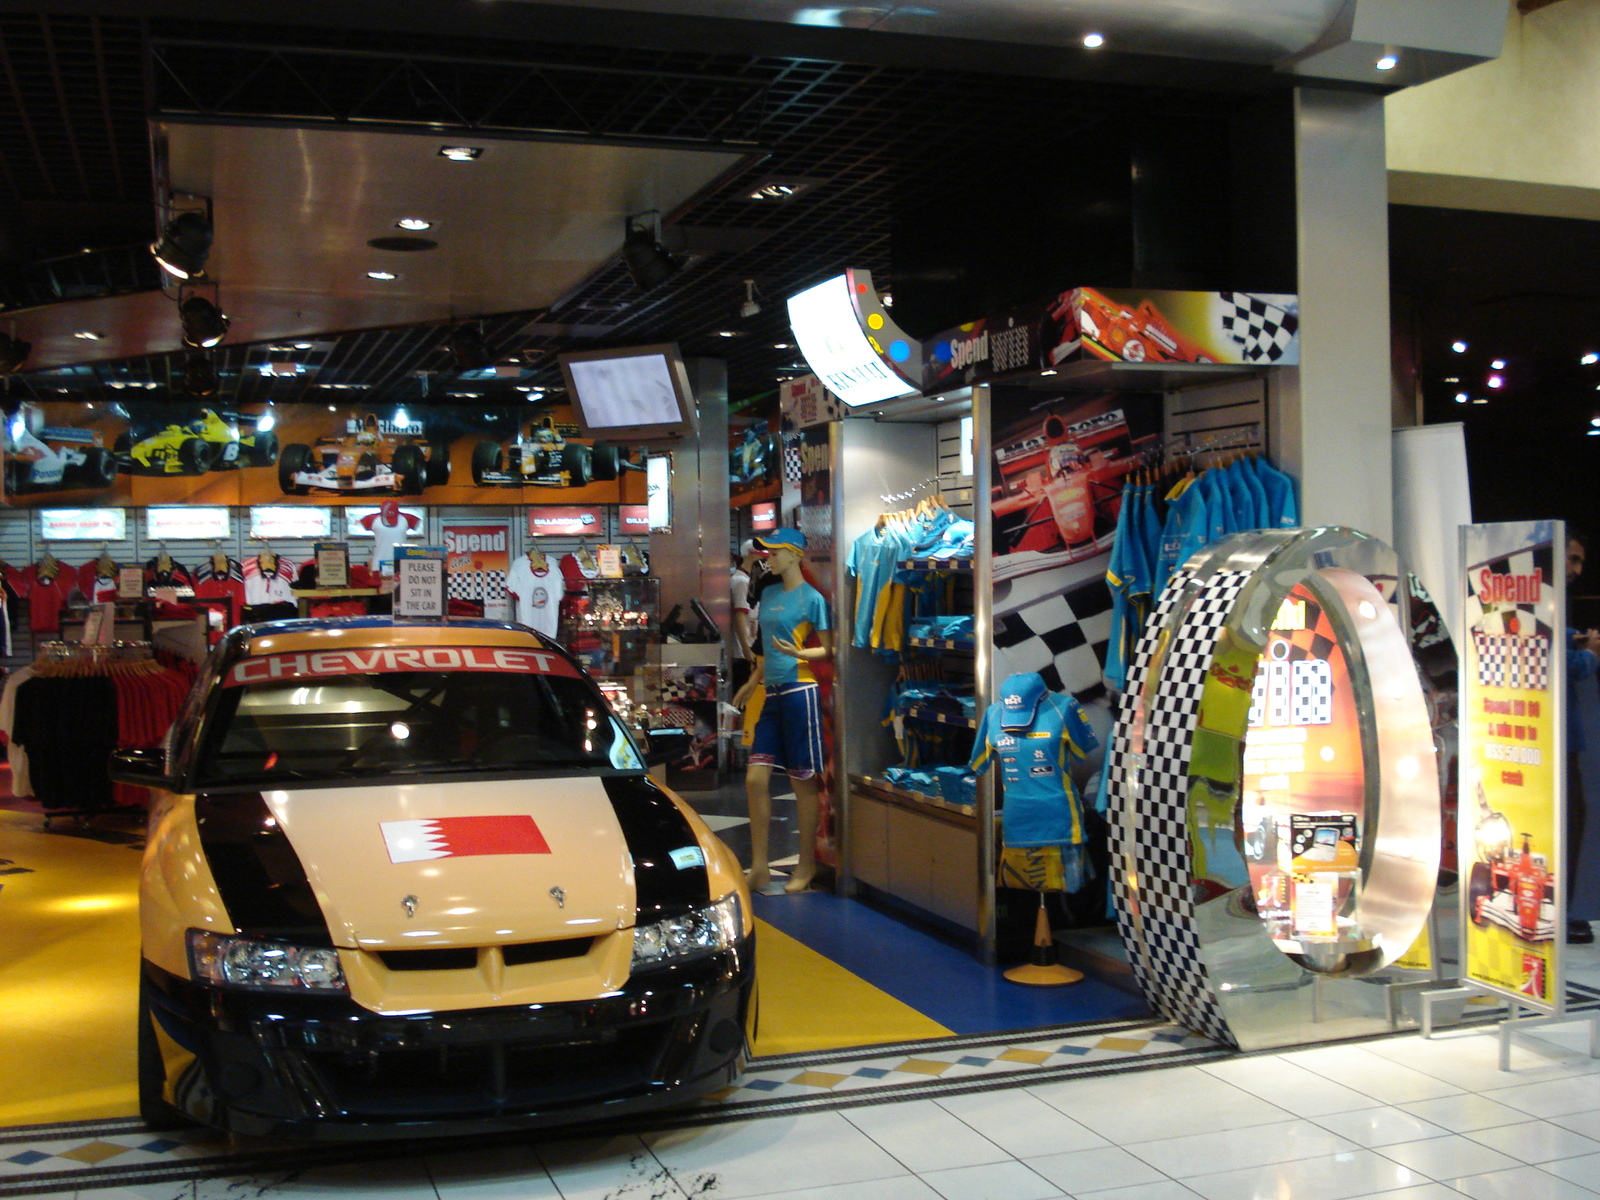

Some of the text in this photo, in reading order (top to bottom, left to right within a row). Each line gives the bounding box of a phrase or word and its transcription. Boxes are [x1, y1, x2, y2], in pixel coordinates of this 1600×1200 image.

[950, 329, 988, 370] Spend
[354, 419, 420, 434] Mrlboro
[625, 516, 649, 525] BILLA
[443, 530, 506, 555] Spend
[408, 562, 436, 573] PLEASE
[408, 575, 437, 585] DO NOT
[1479, 567, 1542, 604] Spend
[410, 588, 433, 598] SIT IN
[406, 601, 437, 611] THE CAR
[233, 649, 556, 683] CHEVROLET
